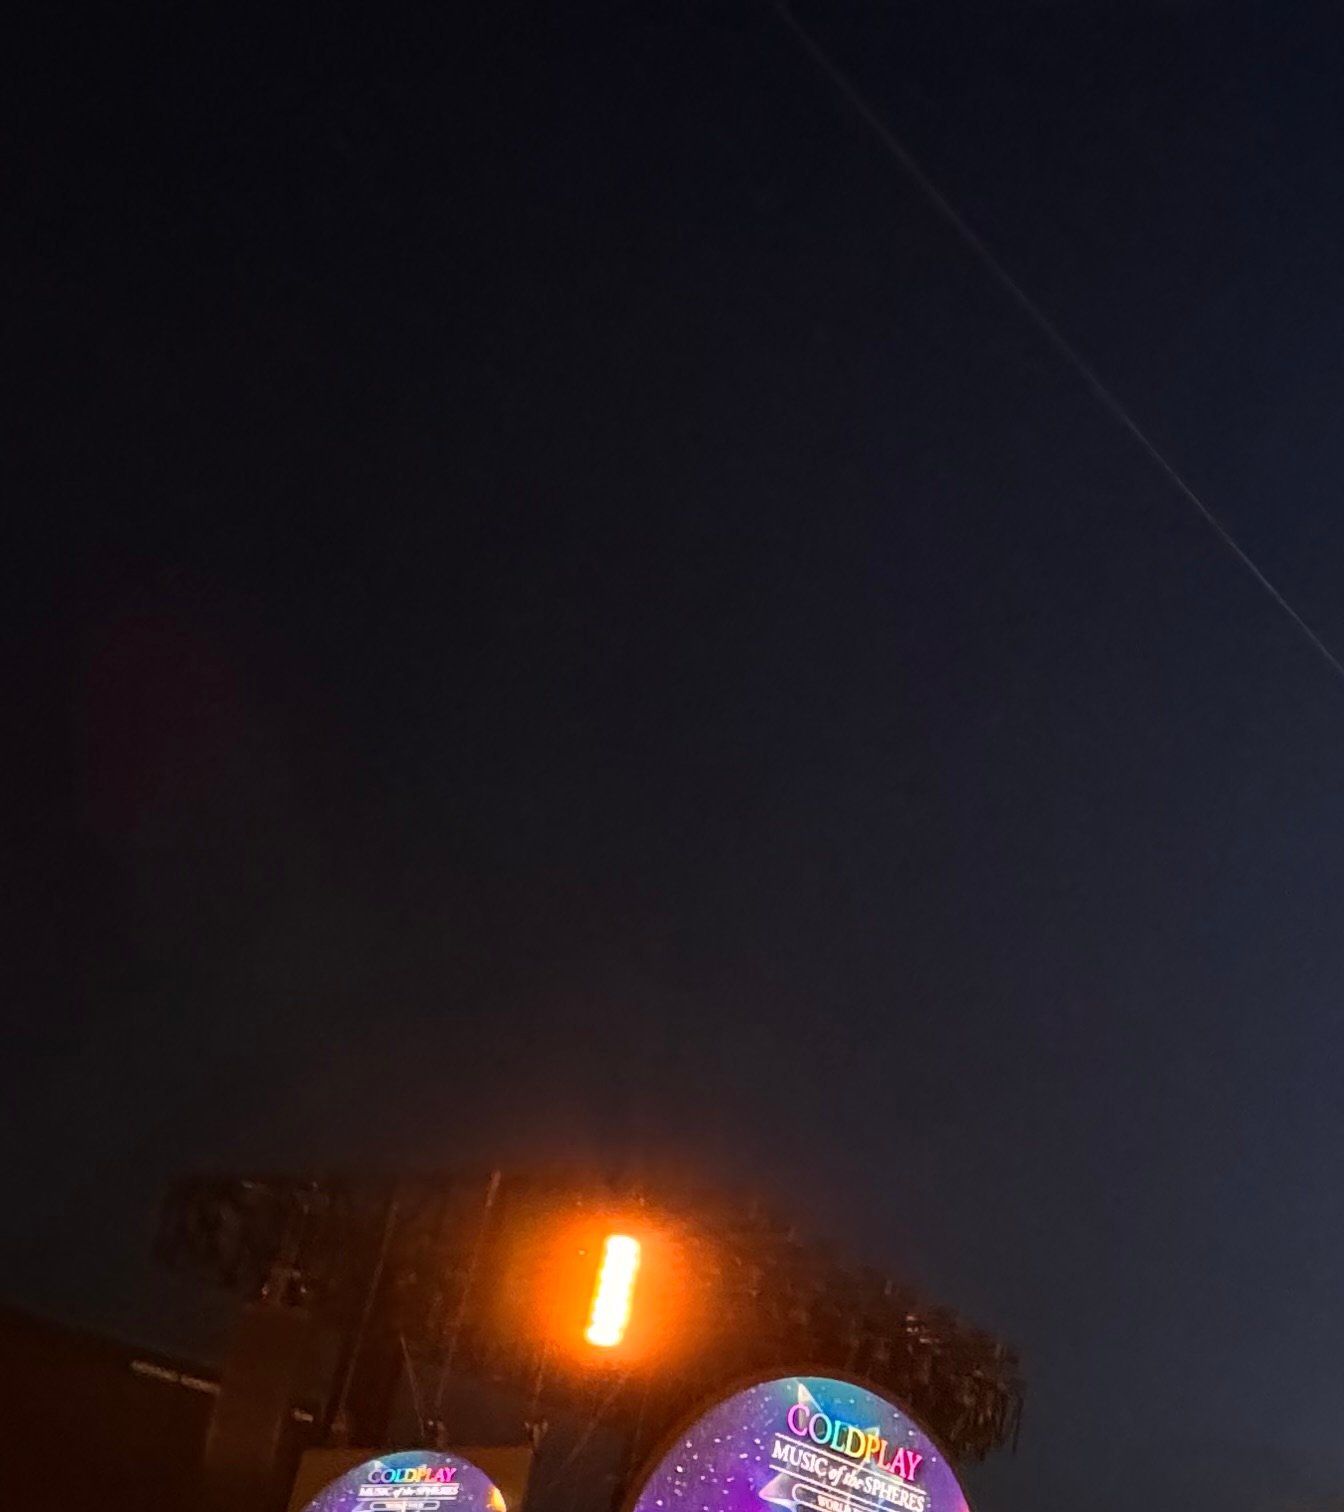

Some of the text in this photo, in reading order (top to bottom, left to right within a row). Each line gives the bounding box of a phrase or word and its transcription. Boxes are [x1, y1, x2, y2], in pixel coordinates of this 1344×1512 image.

[368, 1467, 457, 1483] COLDPLAY
[771, 1440, 925, 1512] MUSIC of the SPHERES
[787, 1403, 922, 1481] COLDPLAY
